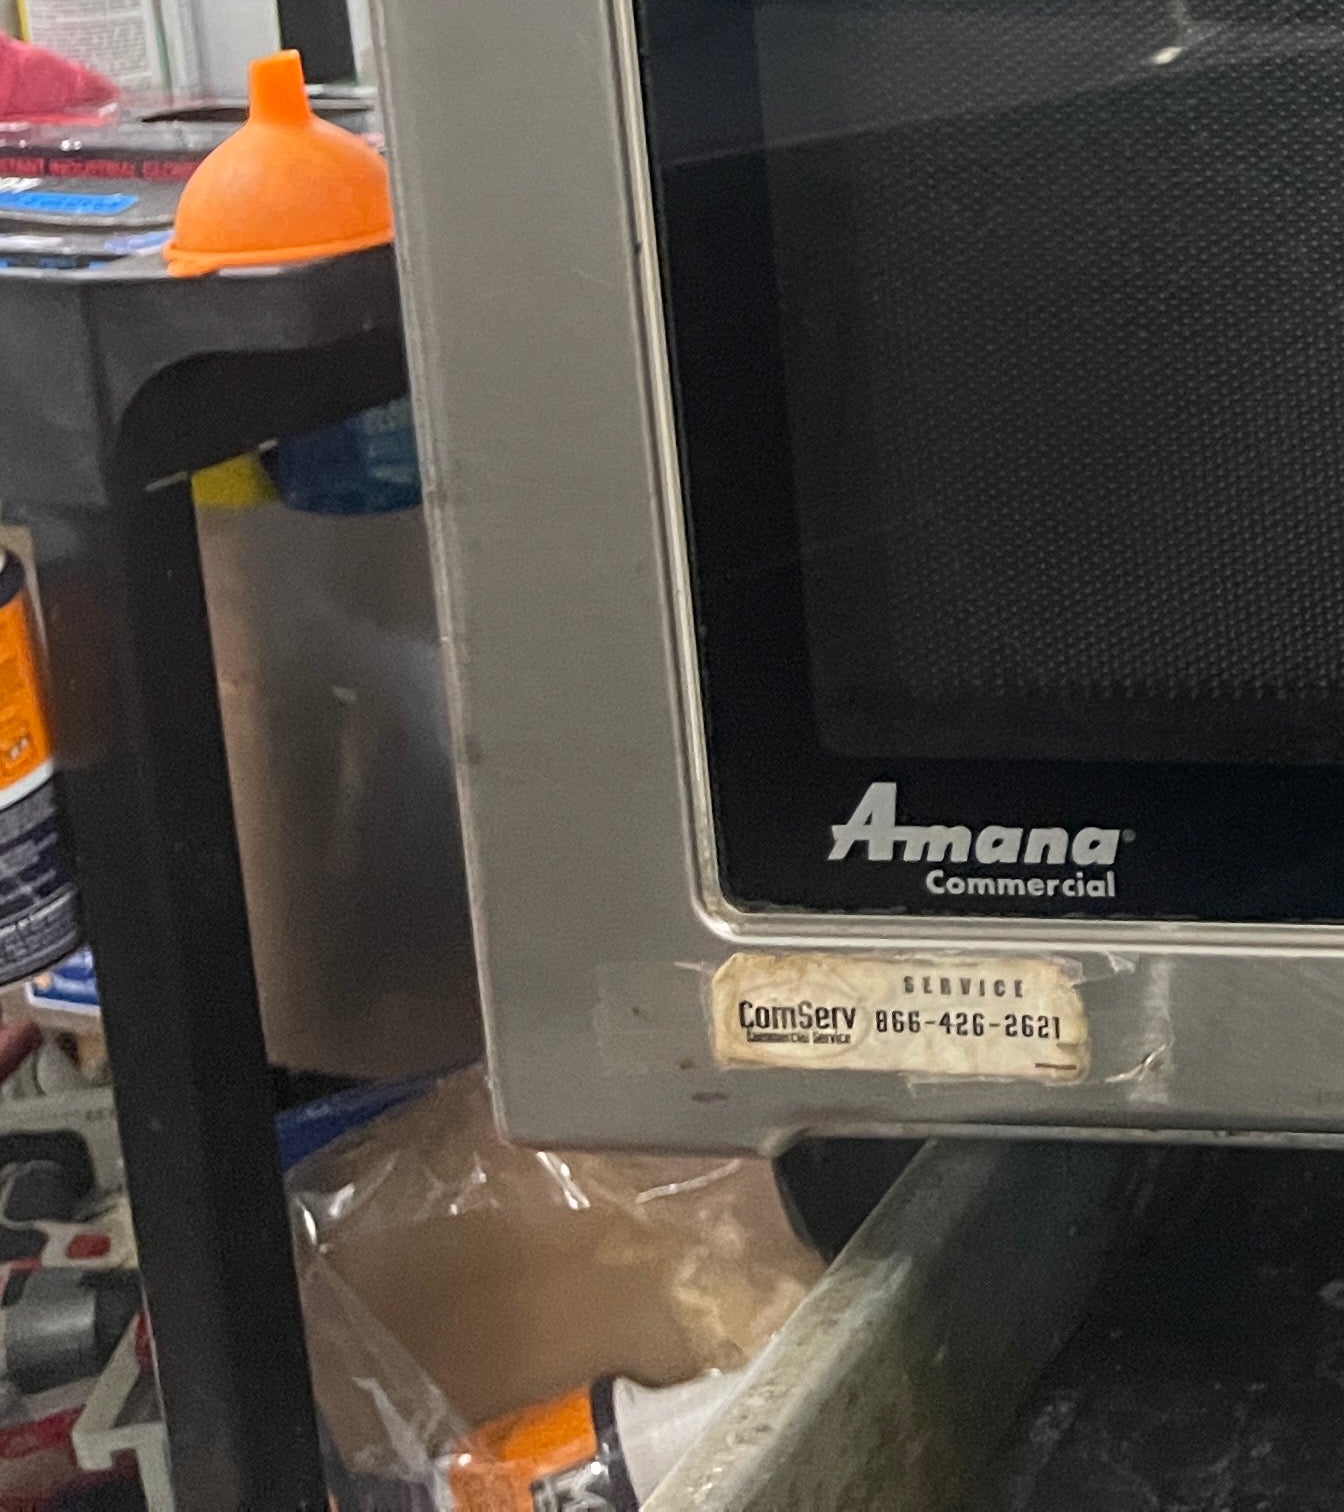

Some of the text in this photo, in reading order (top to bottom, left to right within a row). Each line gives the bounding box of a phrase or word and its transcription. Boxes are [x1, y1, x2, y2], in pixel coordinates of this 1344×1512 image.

[826, 781, 1121, 866] Amana
[925, 868, 1117, 899] Commercial
[903, 975, 1023, 999] SERVICE
[737, 999, 857, 1031] ComServ
[875, 1009, 1061, 1040] 866-426-2621
